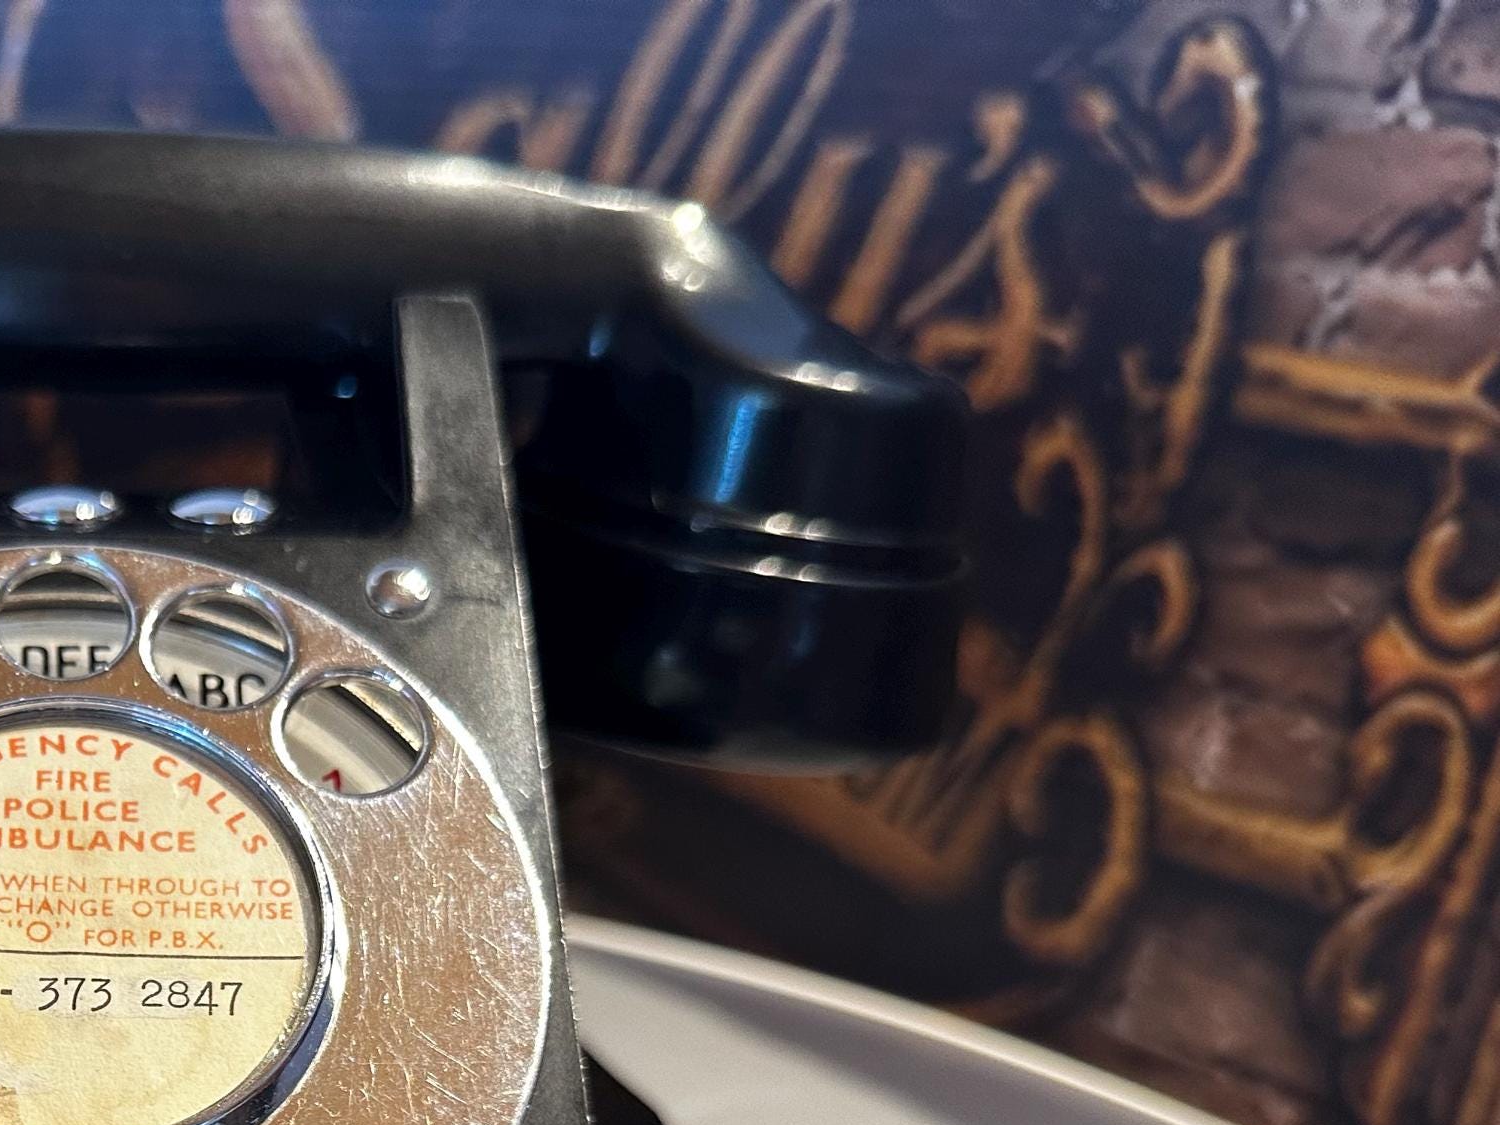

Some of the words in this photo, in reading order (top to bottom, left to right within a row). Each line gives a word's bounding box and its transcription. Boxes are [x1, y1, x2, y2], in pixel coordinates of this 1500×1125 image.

[36, 770, 111, 793] FIRE
[4, 798, 139, 822] POLICE
[151, 755, 269, 854] CALLS
[0, 874, 87, 893] WHEN
[100, 877, 240, 898] THROUGH
[252, 879, 291, 898] TO
[132, 900, 293, 920] OTHERWISE
[84, 928, 137, 947] FOR
[149, 929, 224, 950] P.B.X.
[38, 977, 113, 1012] 373
[141, 979, 243, 1016] 2847
